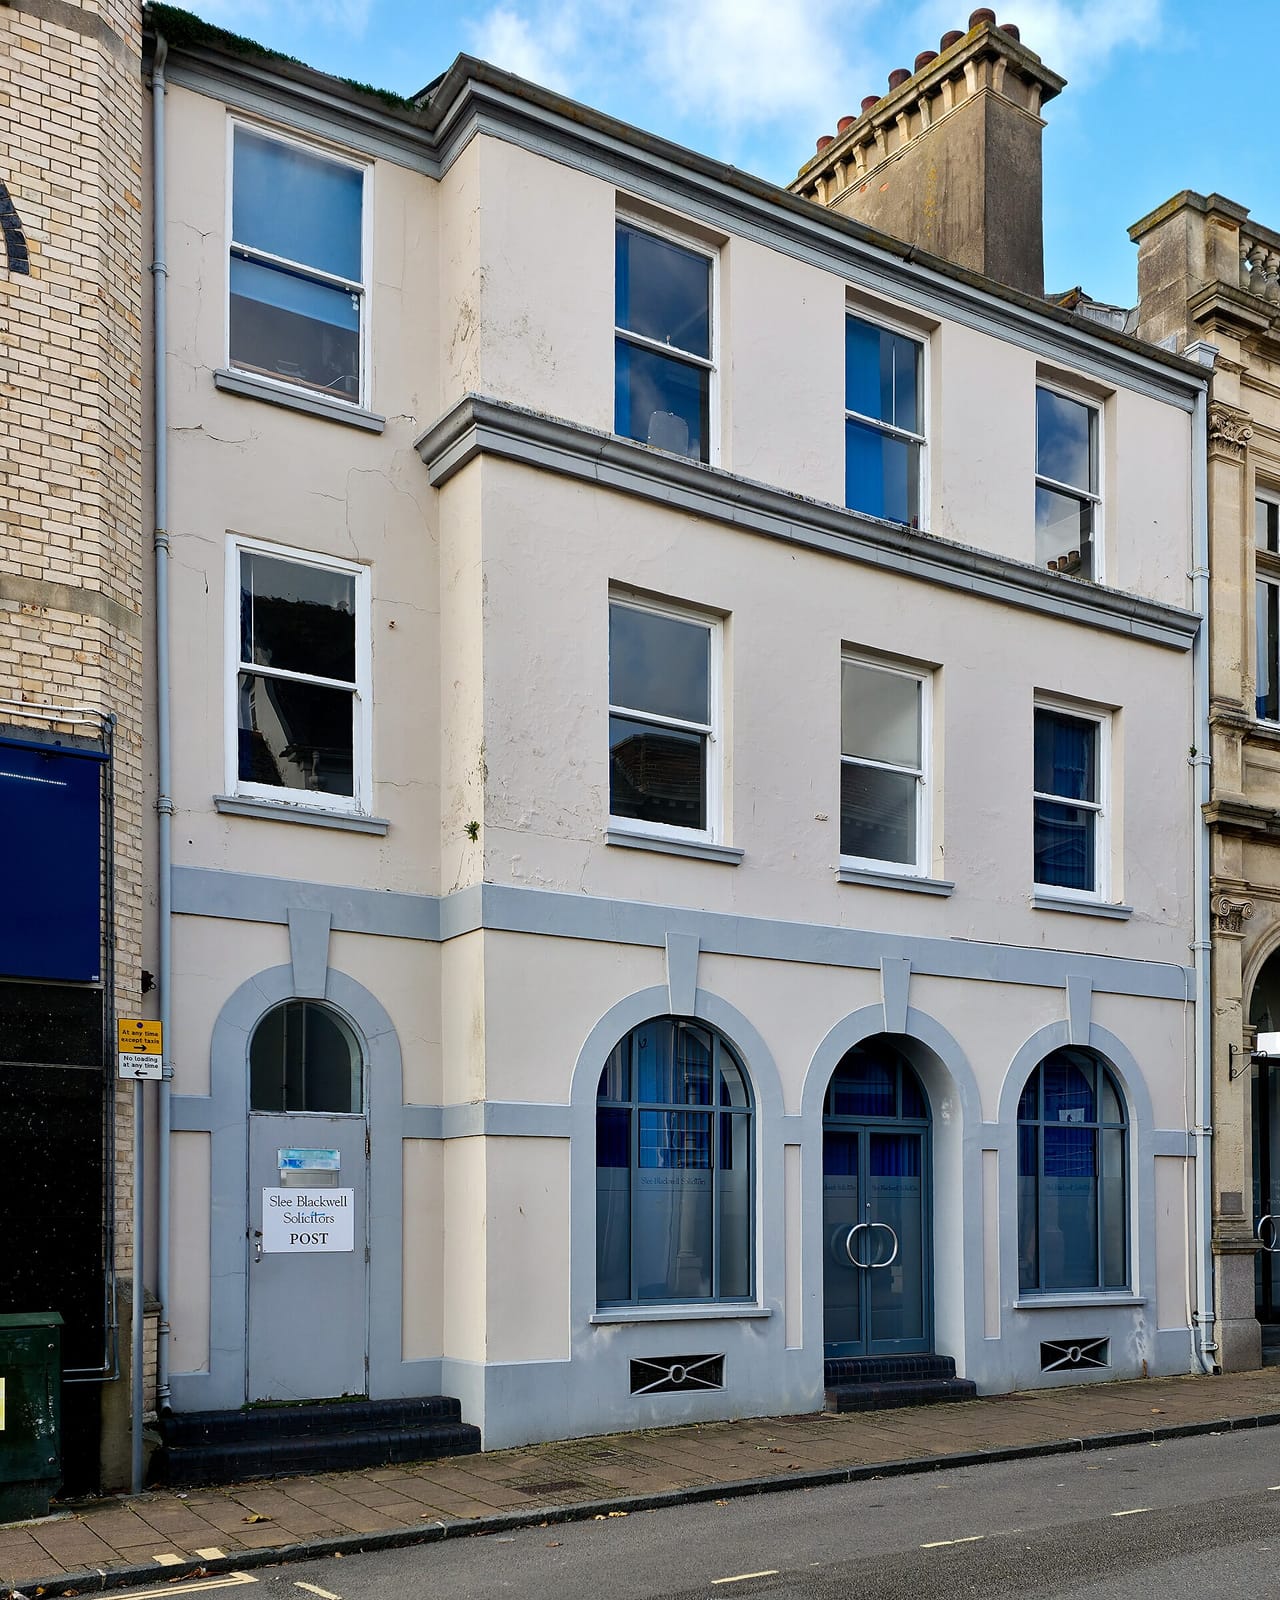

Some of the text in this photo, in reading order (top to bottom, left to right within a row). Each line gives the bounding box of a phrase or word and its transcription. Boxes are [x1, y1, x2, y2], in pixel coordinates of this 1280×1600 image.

[269, 1195, 347, 1207] Slee Blackwell
[283, 1211, 335, 1224] Solicitors
[290, 1233, 329, 1245] POST
